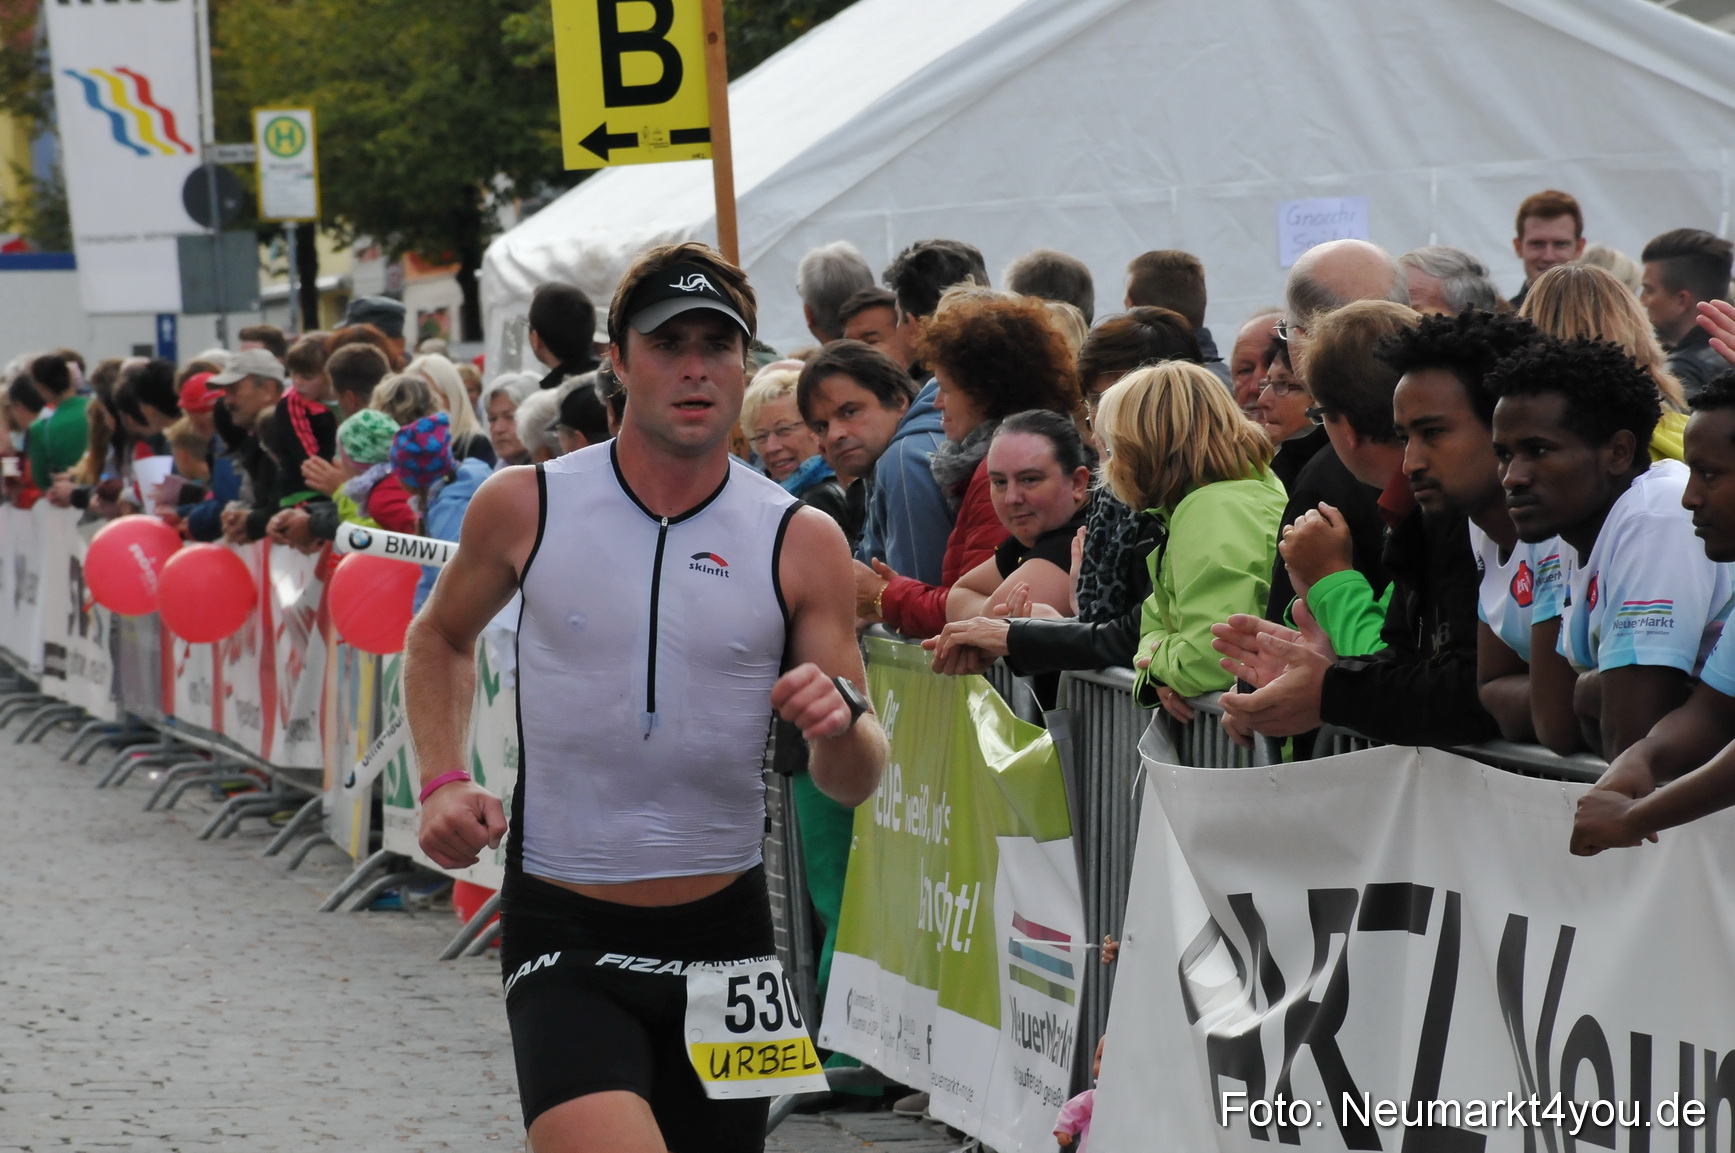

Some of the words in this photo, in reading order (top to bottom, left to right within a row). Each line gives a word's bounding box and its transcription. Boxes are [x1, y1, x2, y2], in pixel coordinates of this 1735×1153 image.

[597, 0, 684, 109] B
[274, 126, 297, 149] H
[385, 535, 438, 560] BMW
[689, 562, 730, 579] skinfit
[725, 971, 803, 1034] 530
[710, 1040, 817, 1079] URBEL
